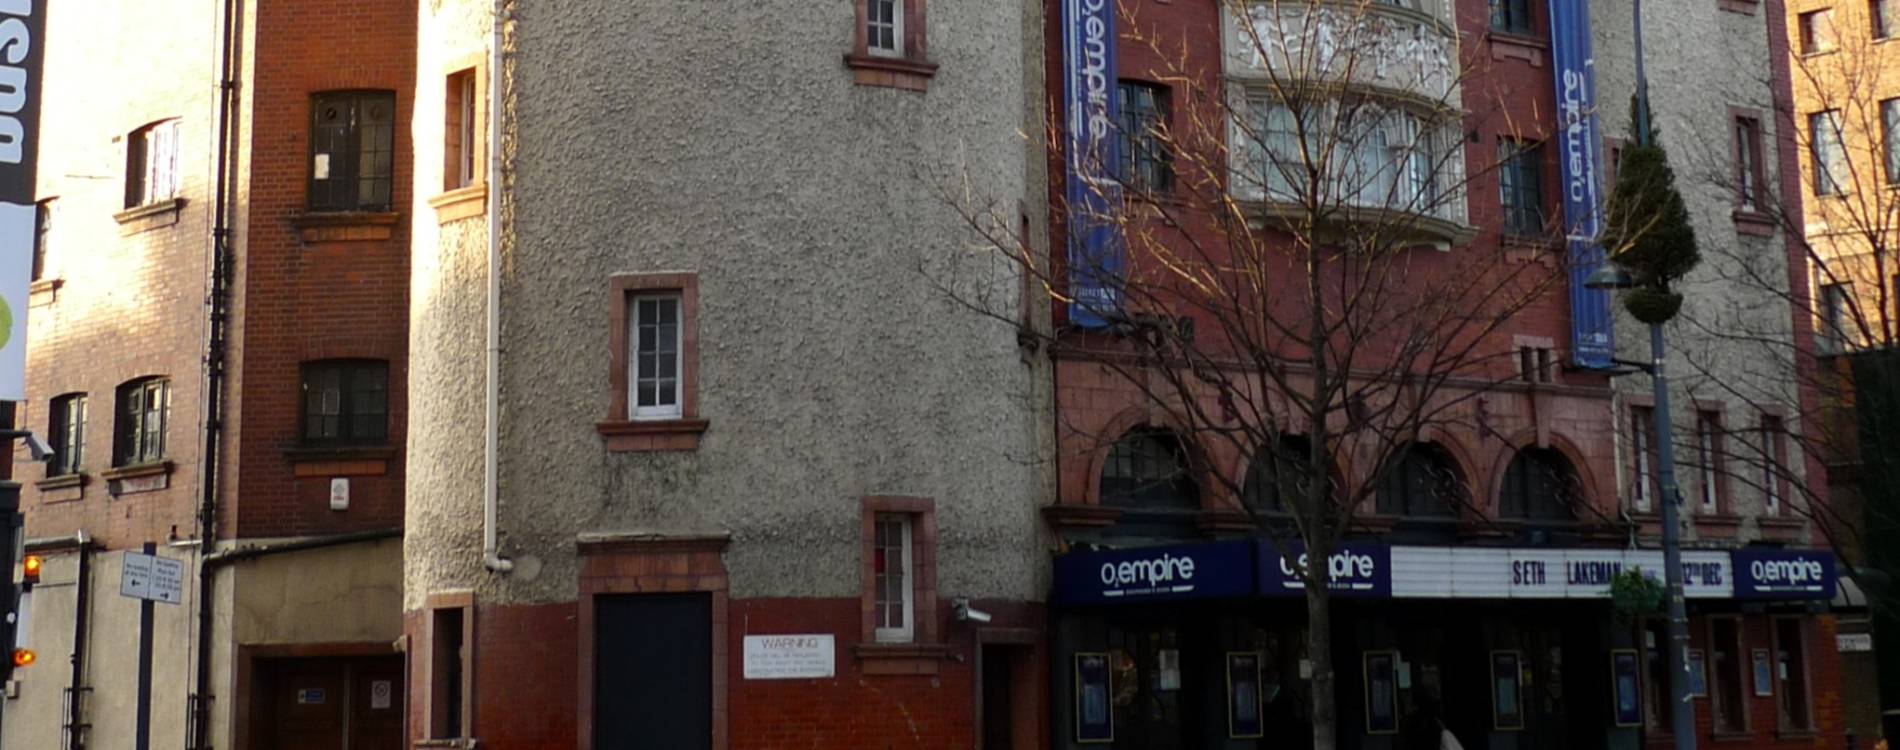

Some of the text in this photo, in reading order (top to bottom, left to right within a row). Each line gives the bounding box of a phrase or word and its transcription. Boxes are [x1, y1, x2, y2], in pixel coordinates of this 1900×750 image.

[1513, 560, 1546, 585] SETH
[1702, 562, 1722, 585] DEC
[761, 638, 819, 649] WARNING
